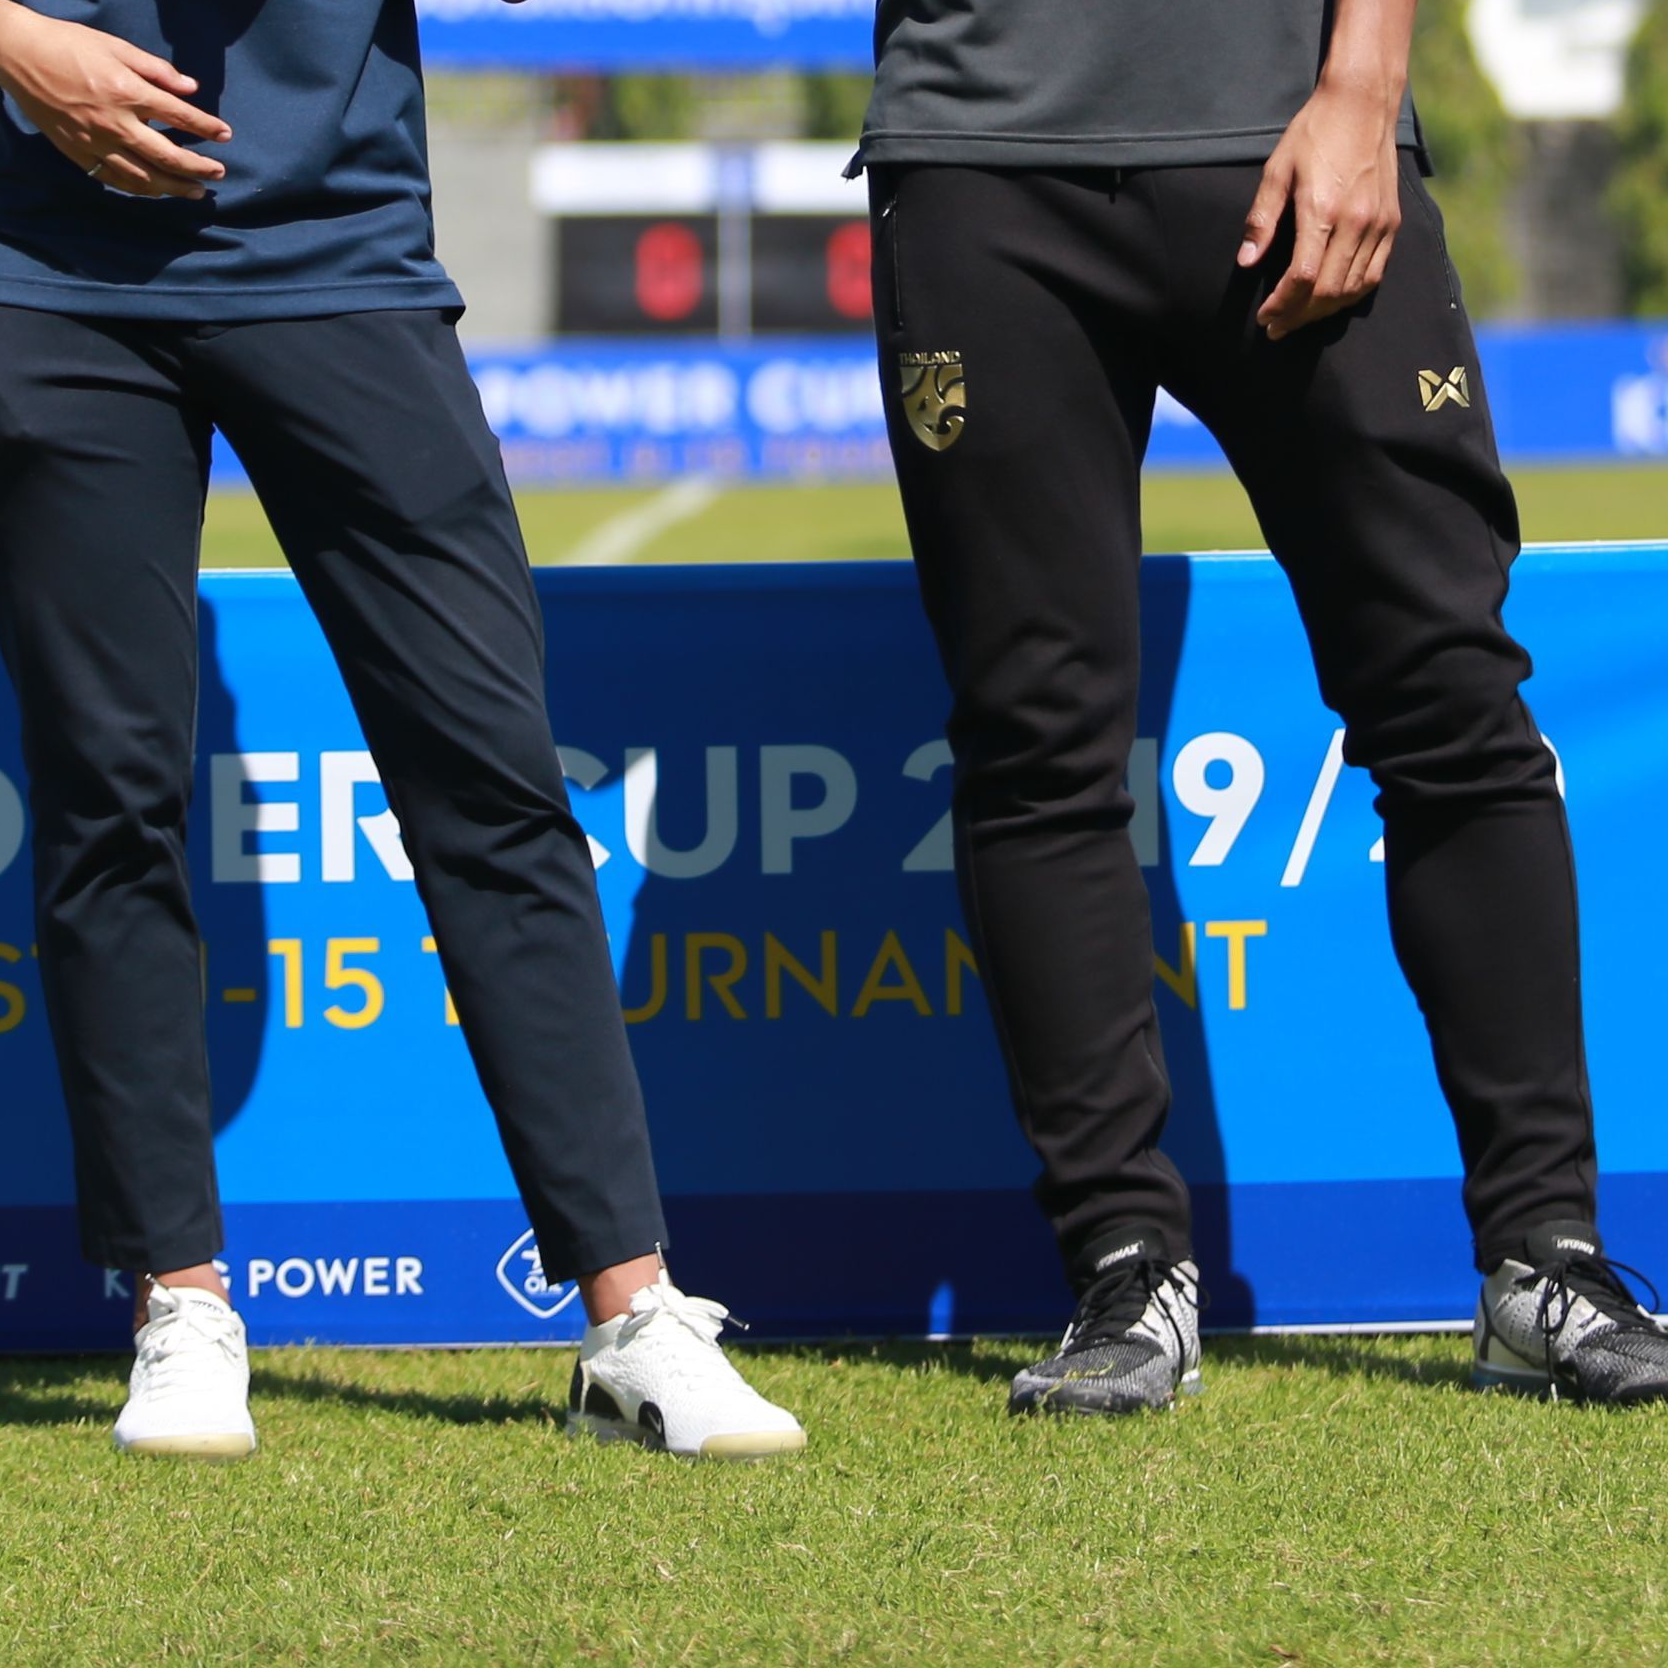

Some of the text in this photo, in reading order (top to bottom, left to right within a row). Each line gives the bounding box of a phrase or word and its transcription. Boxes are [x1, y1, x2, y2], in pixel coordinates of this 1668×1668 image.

[899, 350, 961, 365] THAILAND
[200, 936, 385, 1030] -15
[247, 1256, 424, 1298] POWER
